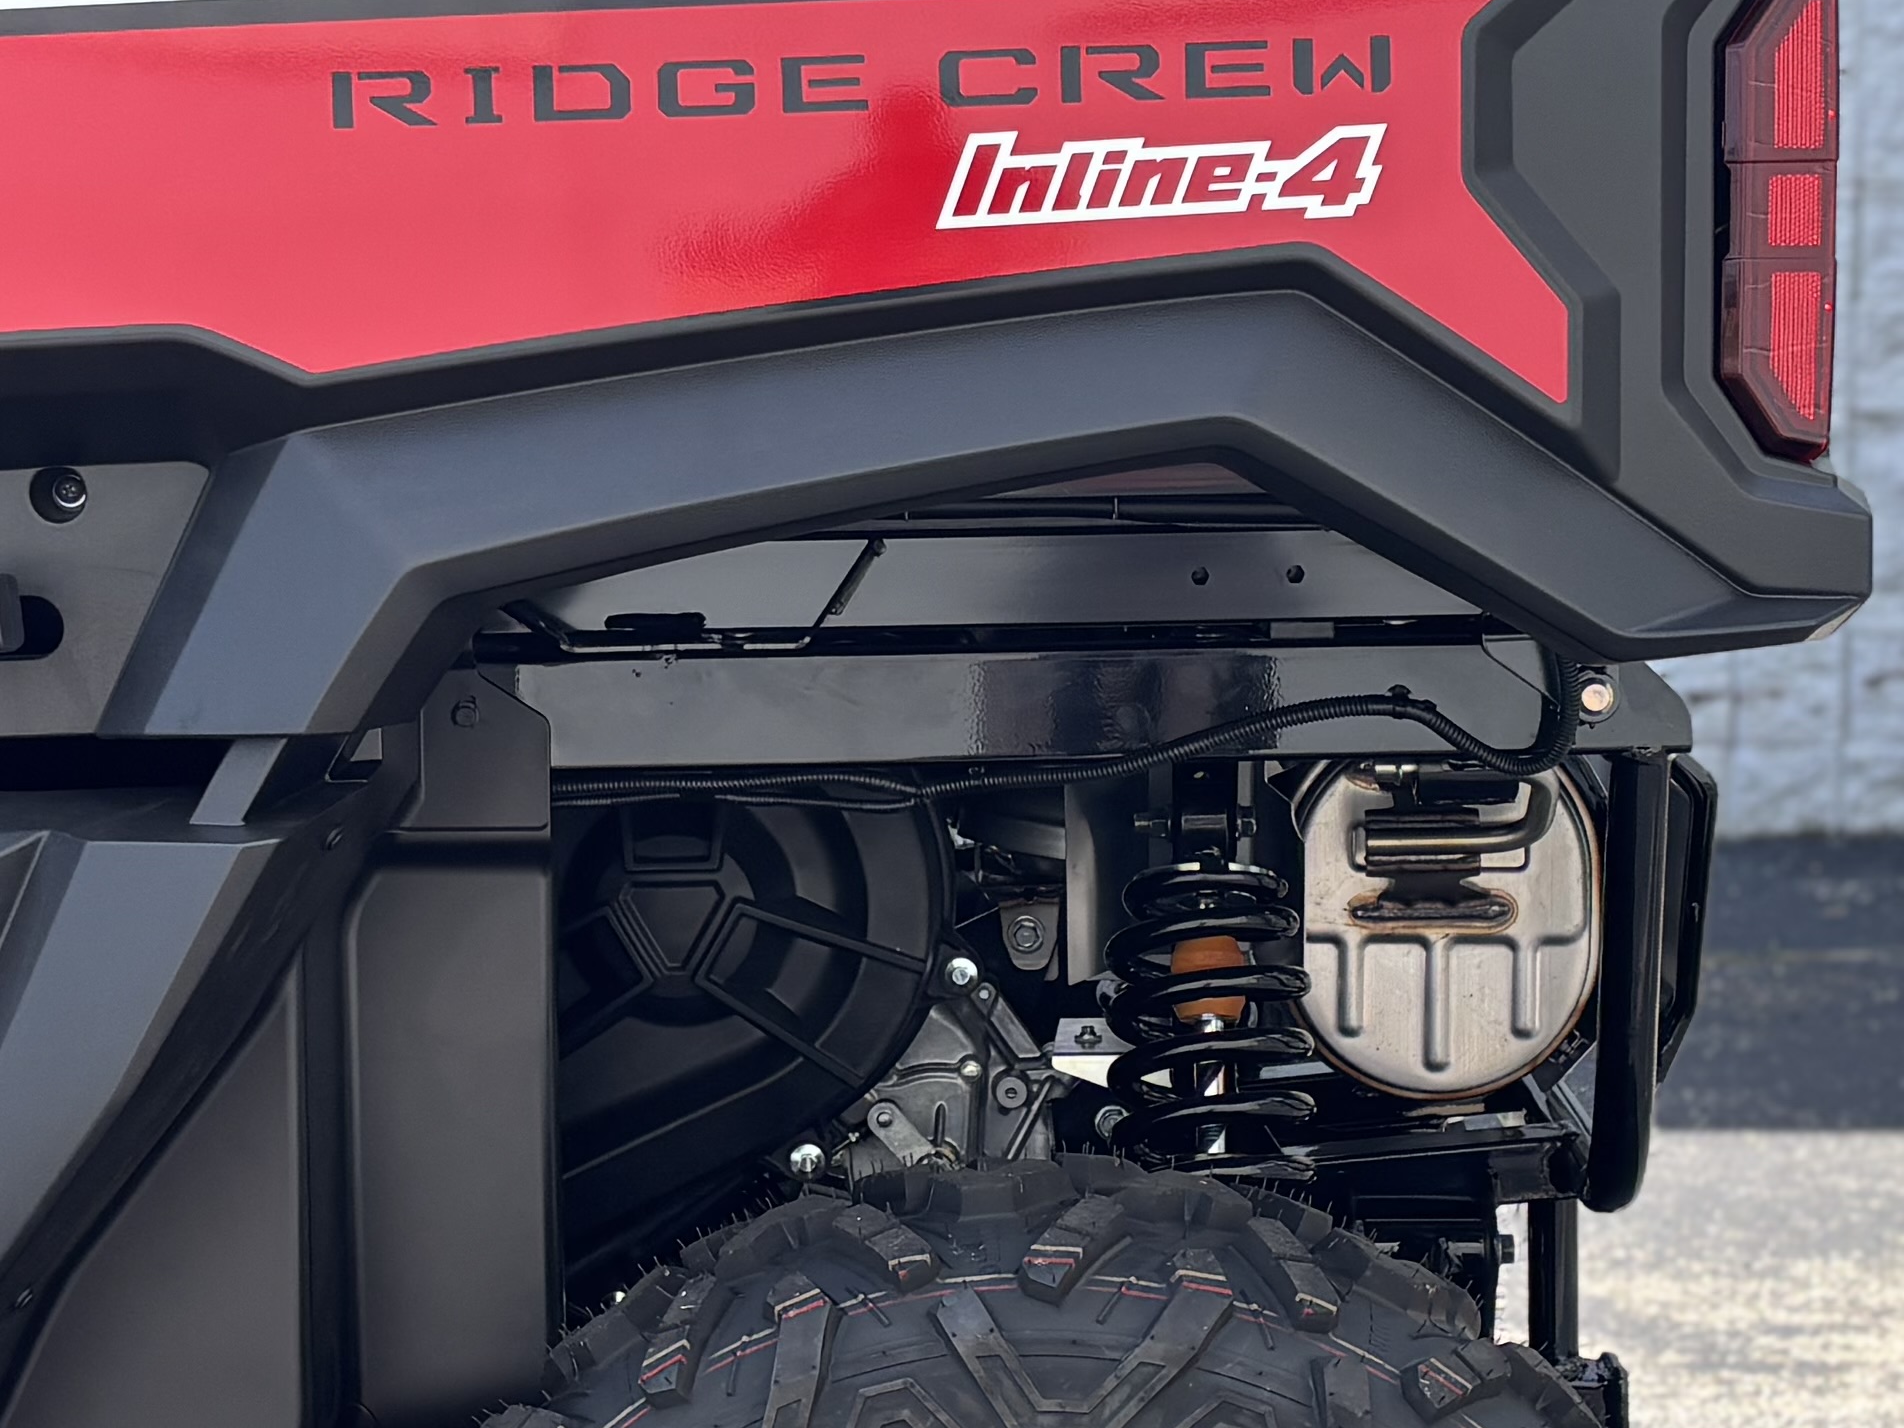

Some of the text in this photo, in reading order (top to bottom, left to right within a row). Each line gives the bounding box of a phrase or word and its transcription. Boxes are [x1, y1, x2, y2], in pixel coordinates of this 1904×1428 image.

[332, 35, 1392, 129] RIDGE CREW
[936, 123, 1387, 229] Inline-4
